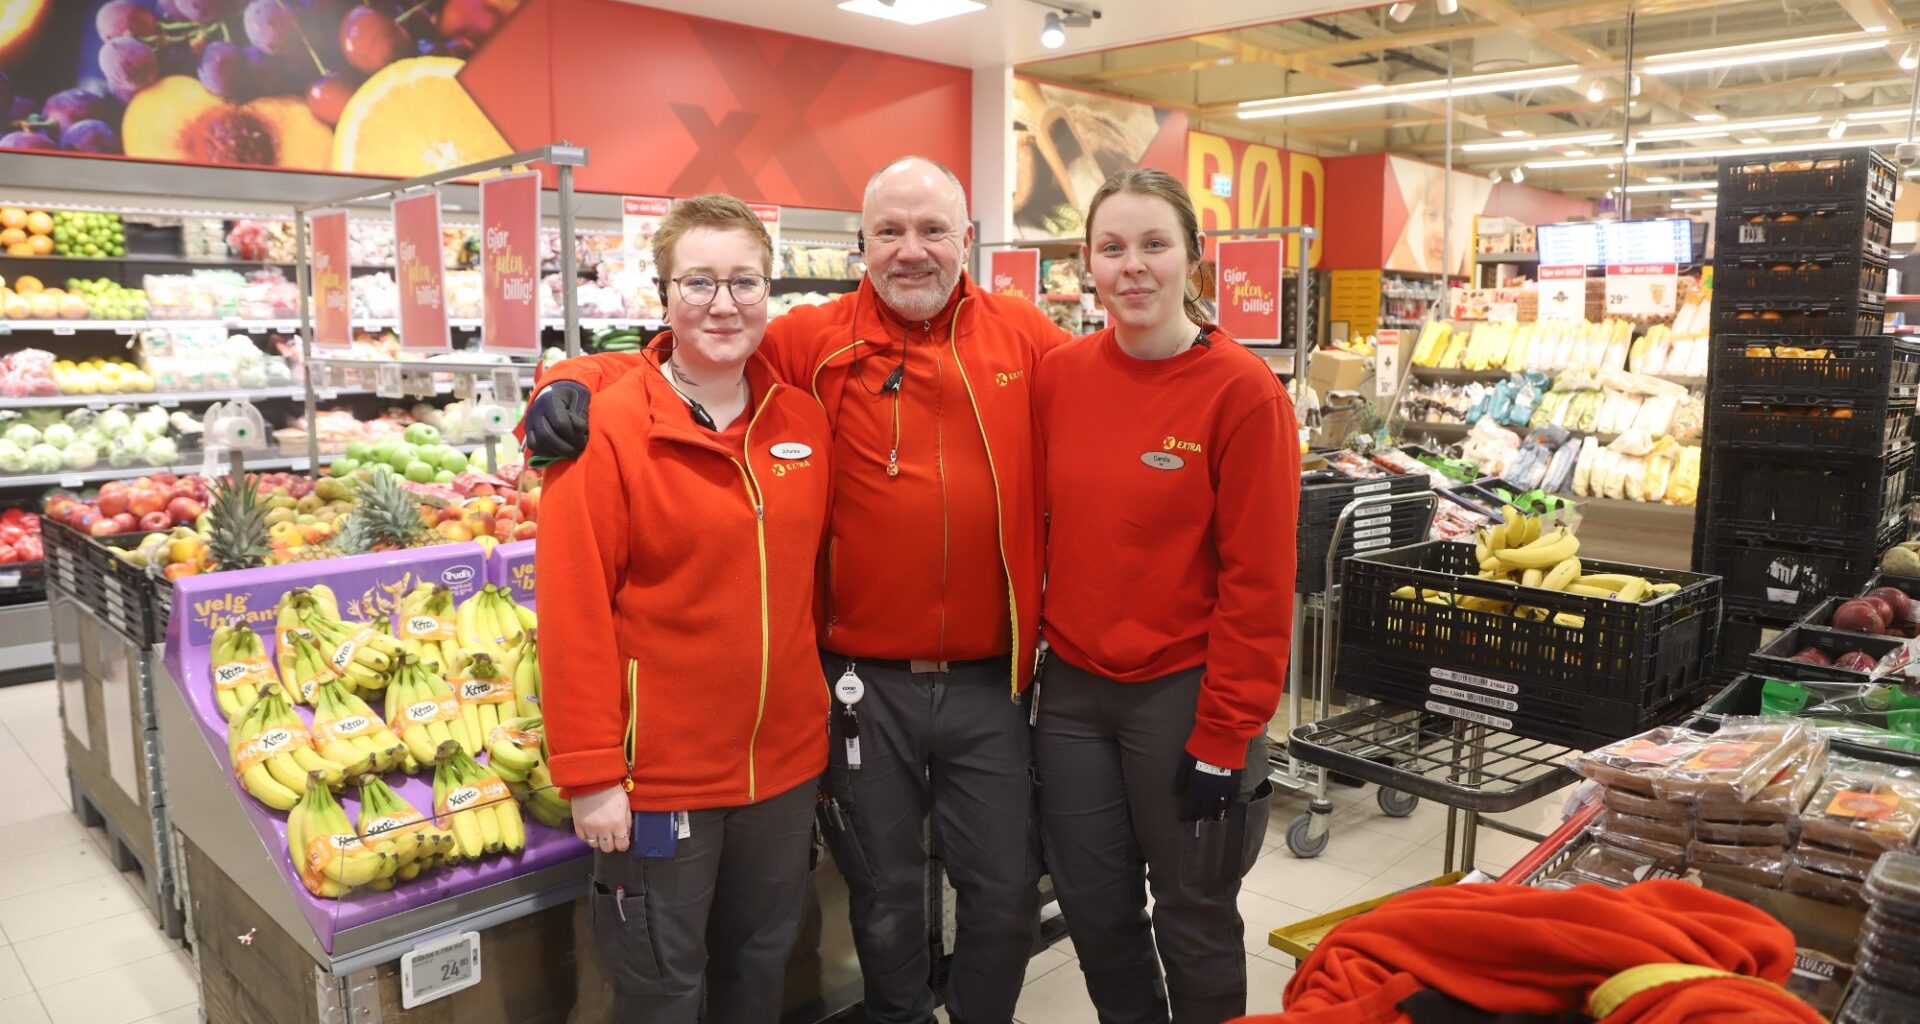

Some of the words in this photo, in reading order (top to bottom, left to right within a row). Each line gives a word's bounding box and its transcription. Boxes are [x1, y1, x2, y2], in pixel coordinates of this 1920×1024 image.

[487, 226, 509, 253] Gjør
[399, 241, 416, 264] Gjør
[493, 246, 524, 288] julen
[994, 274, 1013, 288] Gjør
[1224, 268, 1247, 285] Gjør
[415, 286, 440, 309] billig!
[503, 278, 533, 305] billig!
[1232, 280, 1263, 306] julen
[1610, 294, 1623, 304] 29
[1243, 299, 1273, 315] billig!
[1176, 440, 1202, 453] EXTRA
[786, 460, 811, 471] EXTRA
[511, 564, 535, 578] Ve
[194, 593, 247, 617] Velg
[411, 619, 436, 630] Xtra
[333, 642, 352, 667] Xtra
[218, 666, 246, 681] Xtra
[465, 683, 491, 697] Xtra
[411, 704, 436, 718] Xtra
[340, 718, 365, 731] Xtra
[262, 731, 288, 748] Xtra
[449, 790, 477, 807] Xtra
[441, 961, 459, 981] 24
